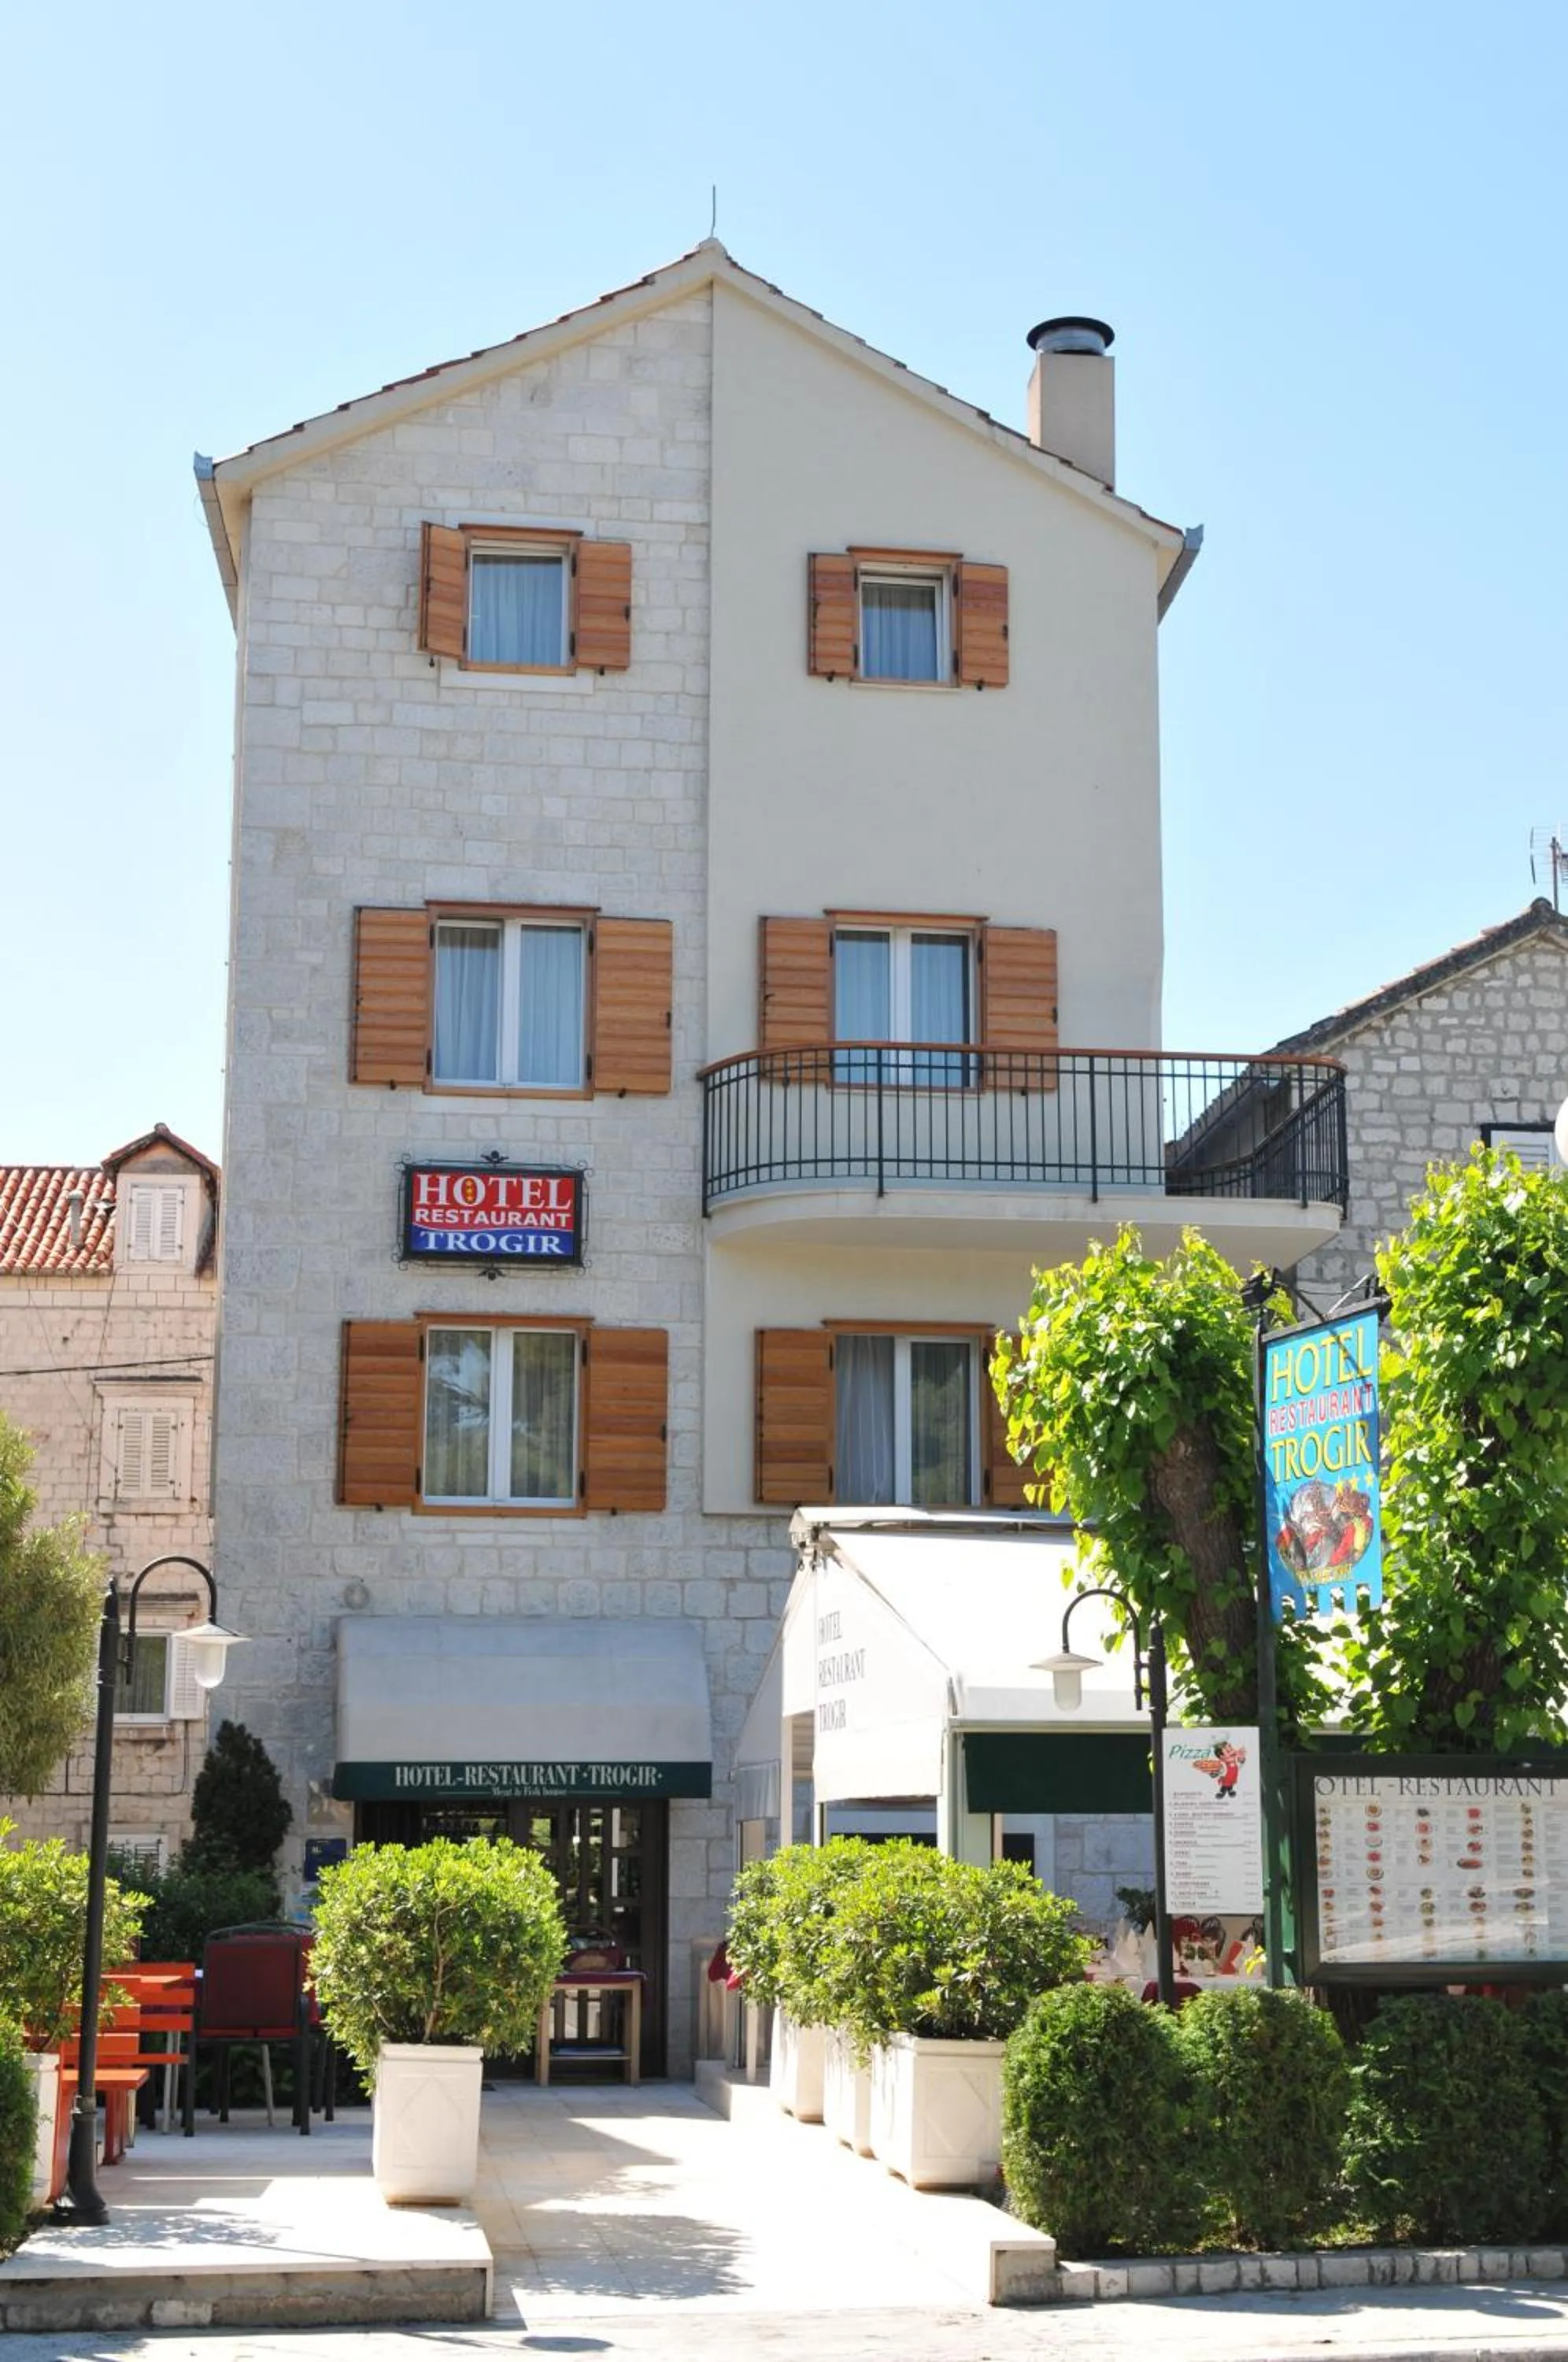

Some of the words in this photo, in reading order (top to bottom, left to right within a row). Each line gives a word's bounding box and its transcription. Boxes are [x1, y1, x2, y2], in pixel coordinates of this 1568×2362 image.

[416, 1173, 572, 1210] HOTEL
[415, 1208, 572, 1227] RESTAURANT
[420, 1231, 565, 1254] TROGIR
[1270, 1326, 1374, 1403] HOTEL
[1268, 1383, 1374, 1436] RESTAURANT
[1270, 1421, 1373, 1486] TROGIR
[819, 1611, 842, 1646] HOTEL
[818, 1648, 866, 1689] RESTAURANT
[819, 1698, 846, 1732] TROGIR
[1169, 1744, 1211, 1760] Pizza
[1315, 1776, 1381, 1796] OTEL
[1397, 1776, 1561, 1797] RESTAURANT
